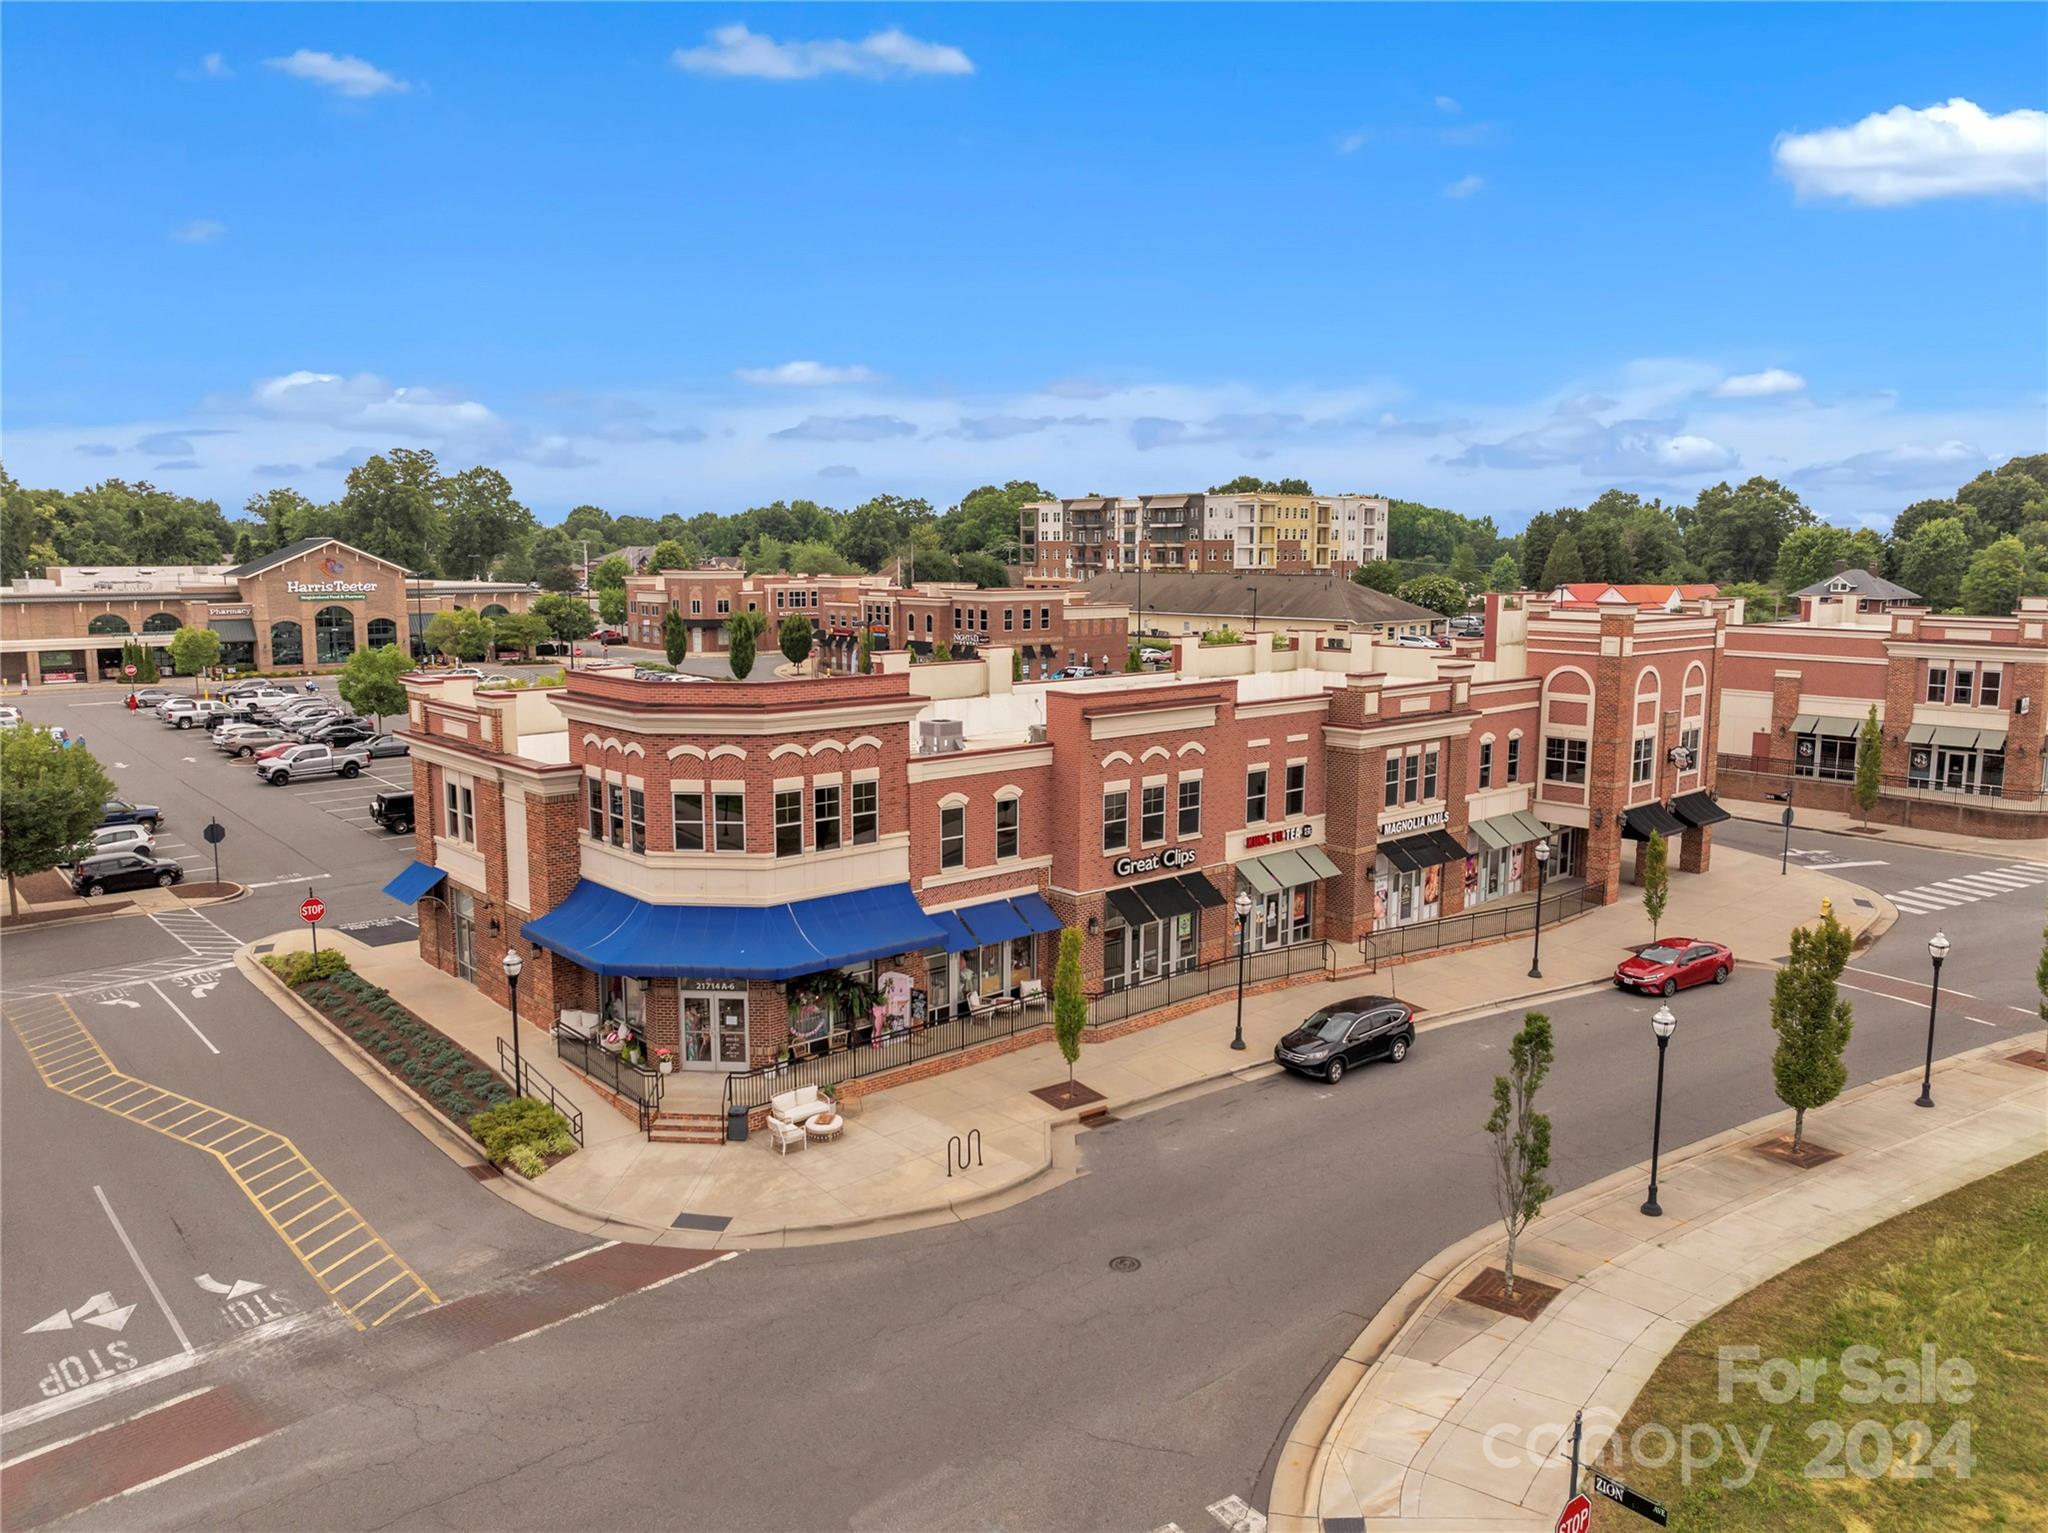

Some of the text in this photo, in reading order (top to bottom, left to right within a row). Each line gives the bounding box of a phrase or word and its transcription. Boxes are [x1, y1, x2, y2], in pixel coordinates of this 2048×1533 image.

[209, 608, 251, 616] Pharmacy
[1382, 811, 1449, 835] MAGNOLIA NAILS
[1116, 848, 1196, 876] Great Clips
[302, 905, 324, 916] STOP
[172, 970, 222, 987] STOP
[38, 1340, 138, 1397] STOP
[1595, 1477, 1625, 1503] ZION
